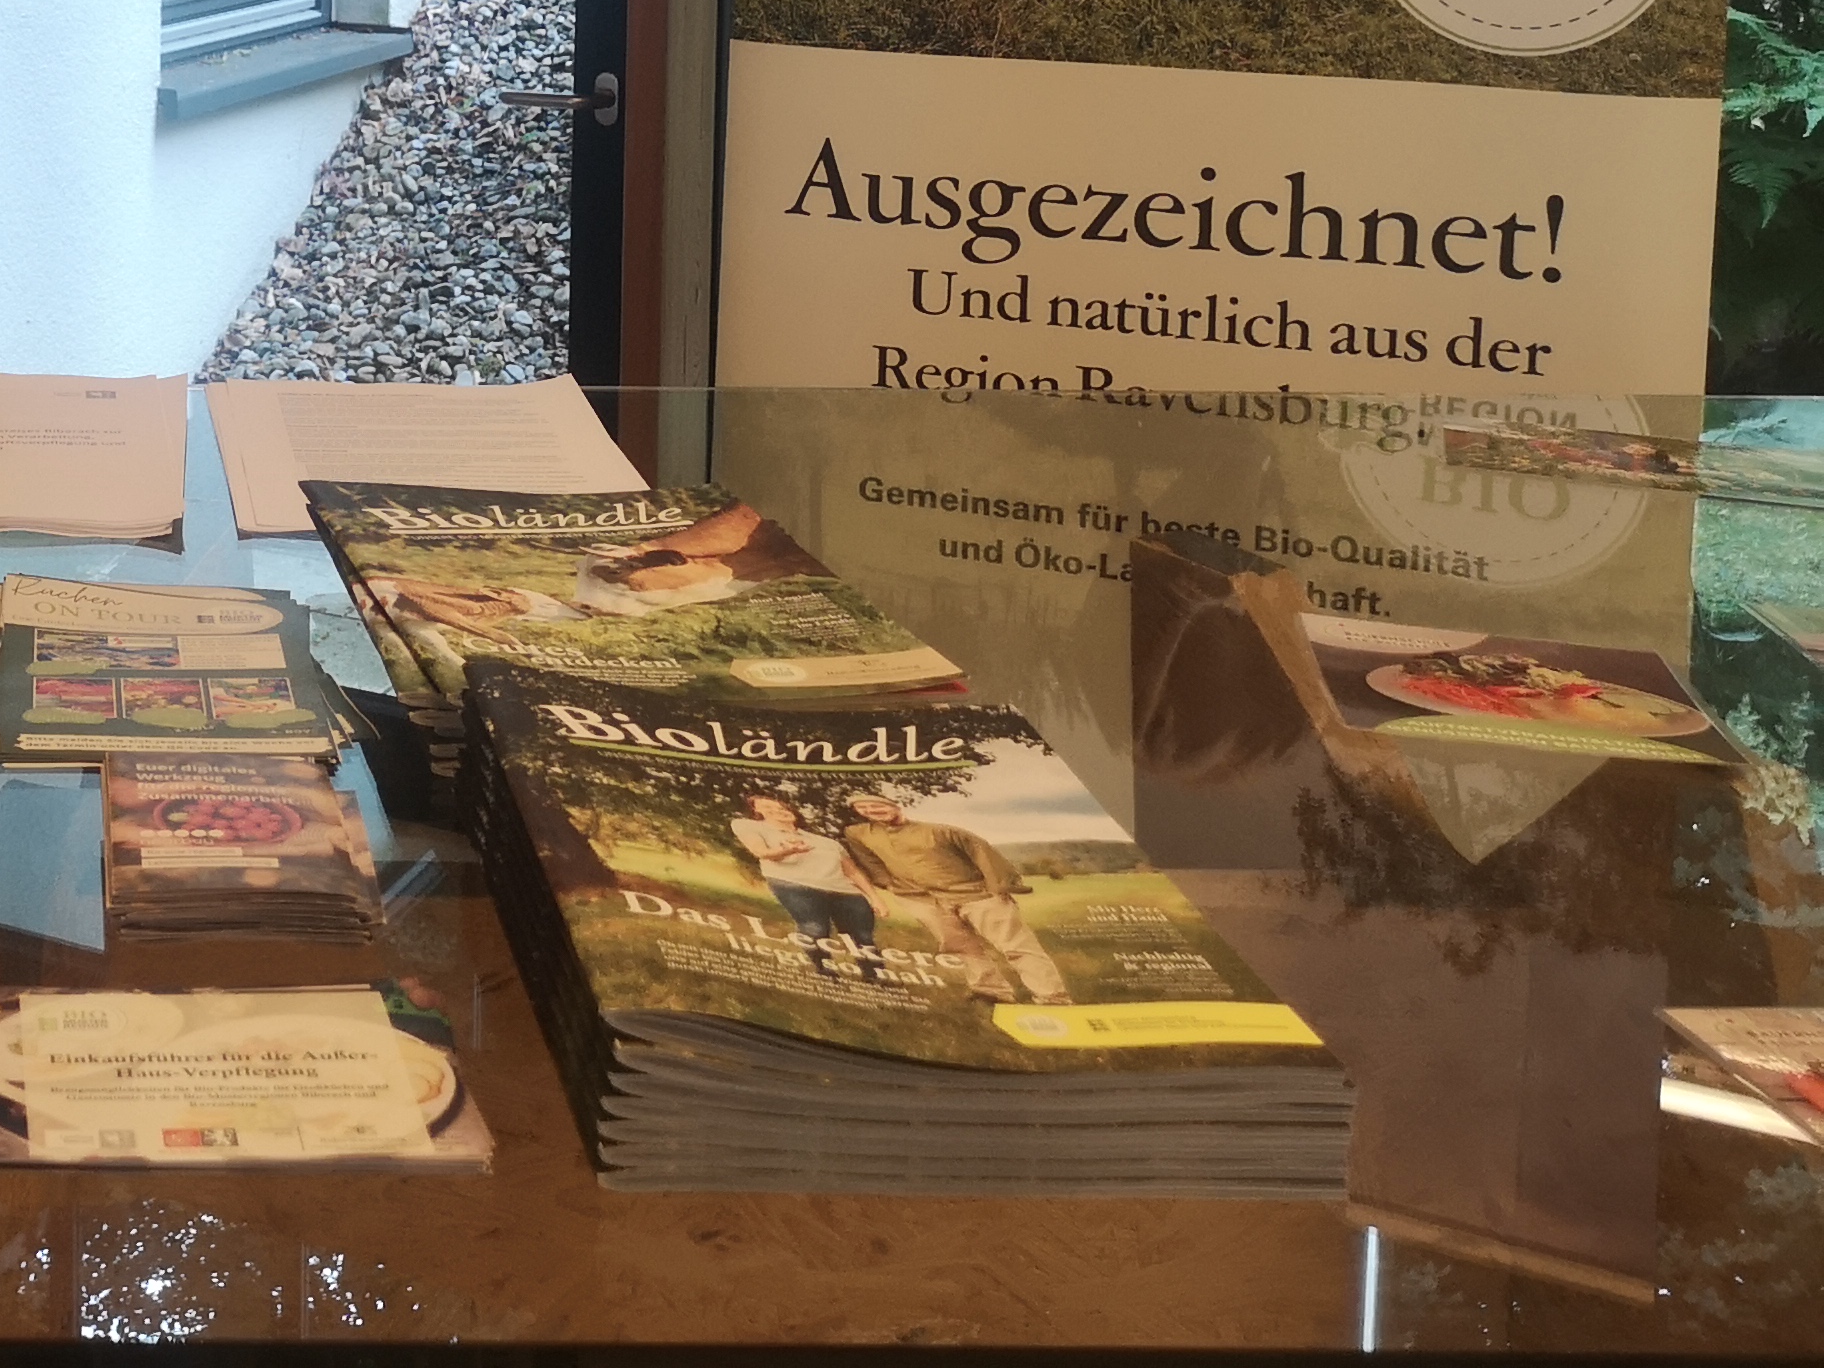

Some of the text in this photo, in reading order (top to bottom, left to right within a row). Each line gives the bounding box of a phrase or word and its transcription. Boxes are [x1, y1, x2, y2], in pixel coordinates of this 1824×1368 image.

[785, 136, 1568, 284] Ausgezeichnet!
[907, 268, 1552, 376] Und natürlich aus der
[872, 345, 1060, 403] Region
[363, 503, 686, 530] Bioländle
[859, 476, 1491, 583] Gemeinsam für beste Bio-Qualität
[939, 537, 1004, 566] und
[34, 601, 81, 618] ON
[90, 608, 182, 625] TOUR
[531, 655, 683, 668] entdecken!
[539, 705, 966, 763] Bioländle
[136, 763, 257, 775] Euer digitales
[136, 773, 226, 783] Werkzeug
[619, 890, 967, 970] Das Leckere
[725, 932, 947, 988] liegt so nah
[49, 1051, 214, 1064] Einkaufsführer
[220, 1051, 254, 1063] für
[260, 1050, 293, 1063] die
[115, 1066, 320, 1080] Haus-Verpflegung
